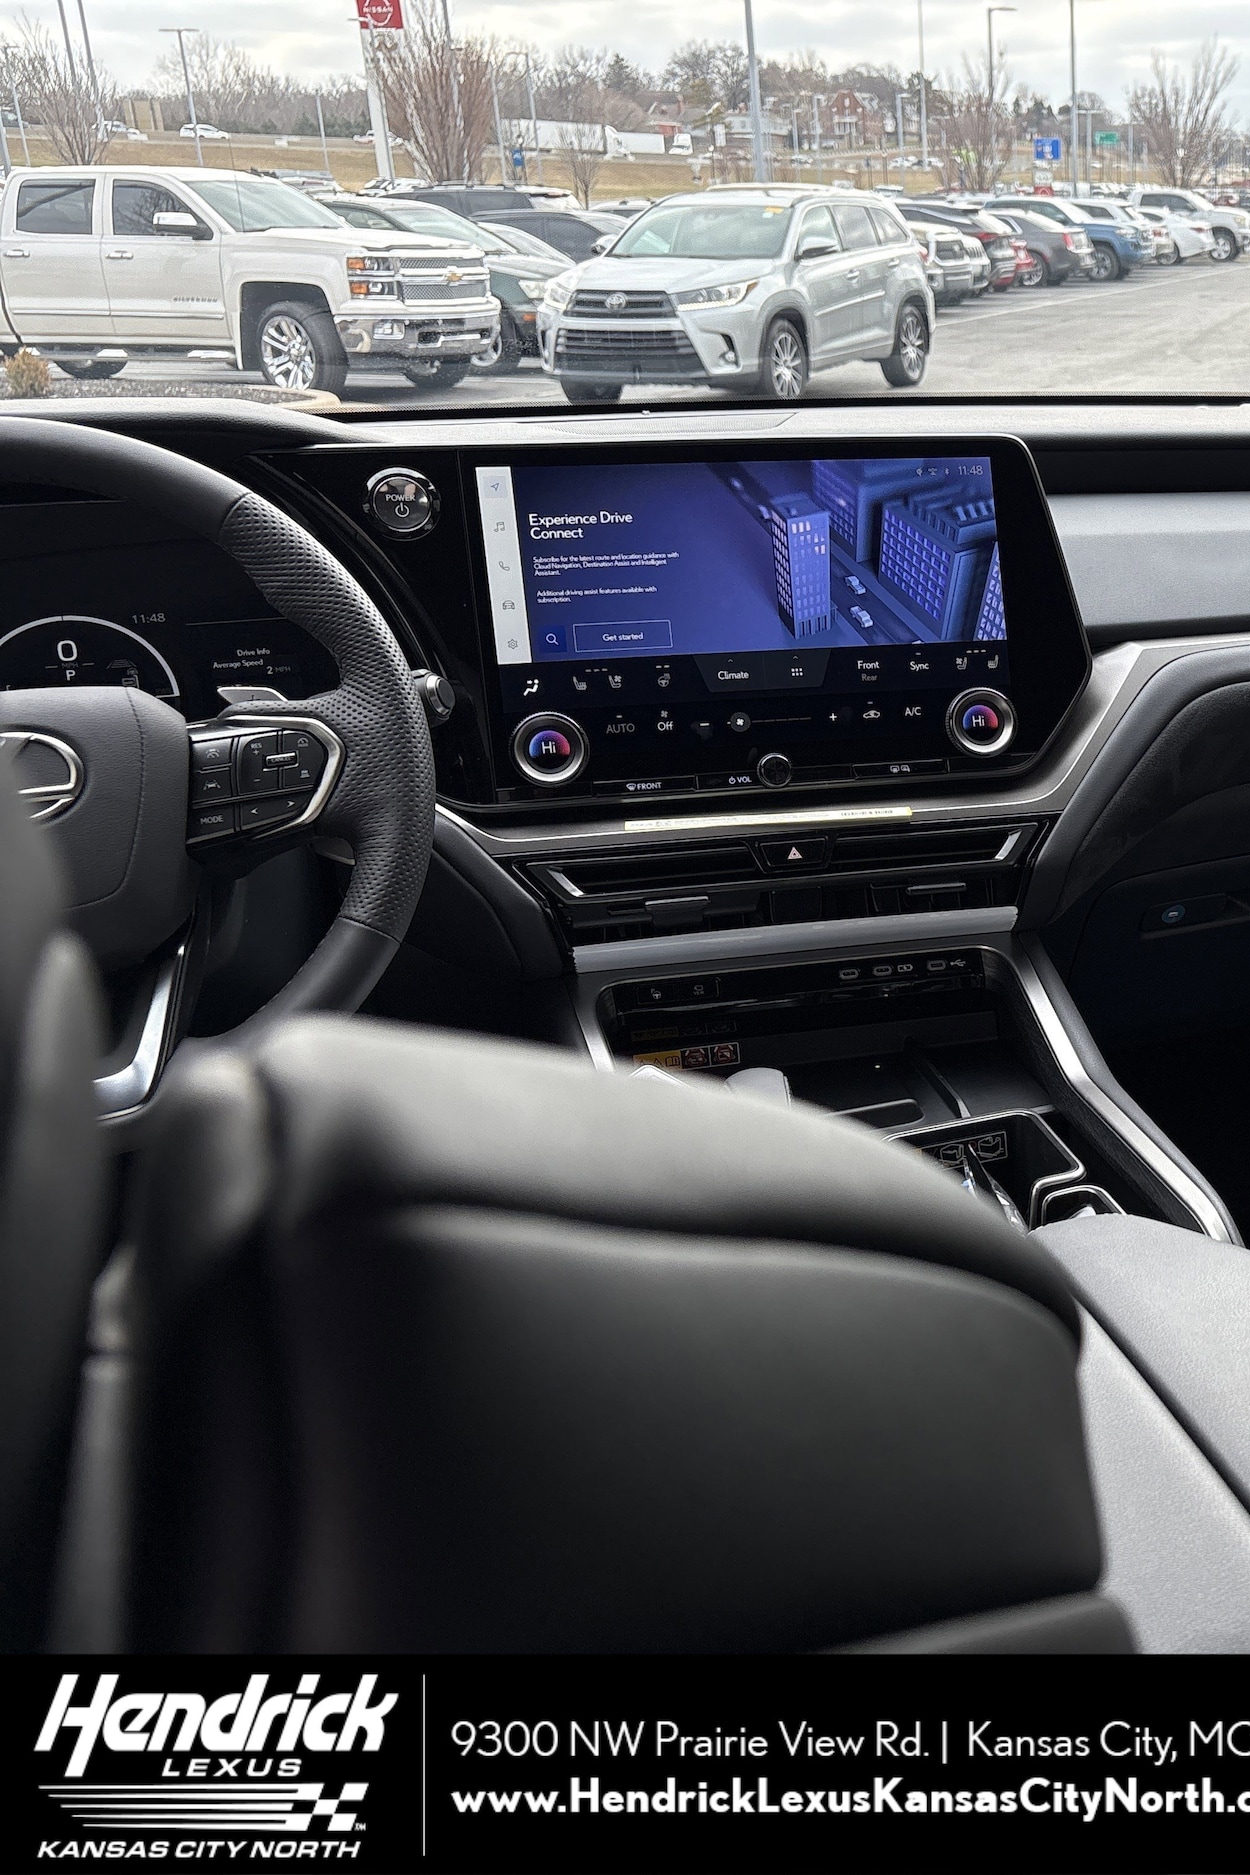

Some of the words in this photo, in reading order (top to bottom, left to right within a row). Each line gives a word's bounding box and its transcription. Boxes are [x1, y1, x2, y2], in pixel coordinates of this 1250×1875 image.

[958, 465, 984, 476] 11:48
[385, 494, 416, 502] POWER
[528, 511, 598, 528] Experience
[599, 511, 633, 524] Drive
[530, 527, 584, 540] Connect
[583, 560, 614, 569] Destination
[536, 590, 565, 598] Additional
[565, 588, 583, 596] driving
[622, 586, 644, 594] available
[132, 613, 166, 624] 11:48
[602, 633, 617, 642] Get
[619, 632, 644, 641] started
[57, 640, 78, 662] 0
[236, 649, 256, 657] Drive
[256, 648, 271, 656] Info
[212, 661, 241, 669] Average
[241, 659, 264, 667] Speed
[857, 661, 880, 670] Front
[909, 661, 930, 671] Sync
[65, 670, 76, 681] P
[266, 666, 274, 675] 2
[717, 670, 750, 680] Climate
[861, 673, 878, 682] Rear
[904, 706, 922, 717] A/C
[972, 715, 985, 727] Hi
[605, 723, 636, 735] AUTO
[657, 721, 674, 732] Off
[541, 741, 557, 755] Hi
[637, 782, 662, 790] FRONT
[200, 815, 224, 825] MODE
